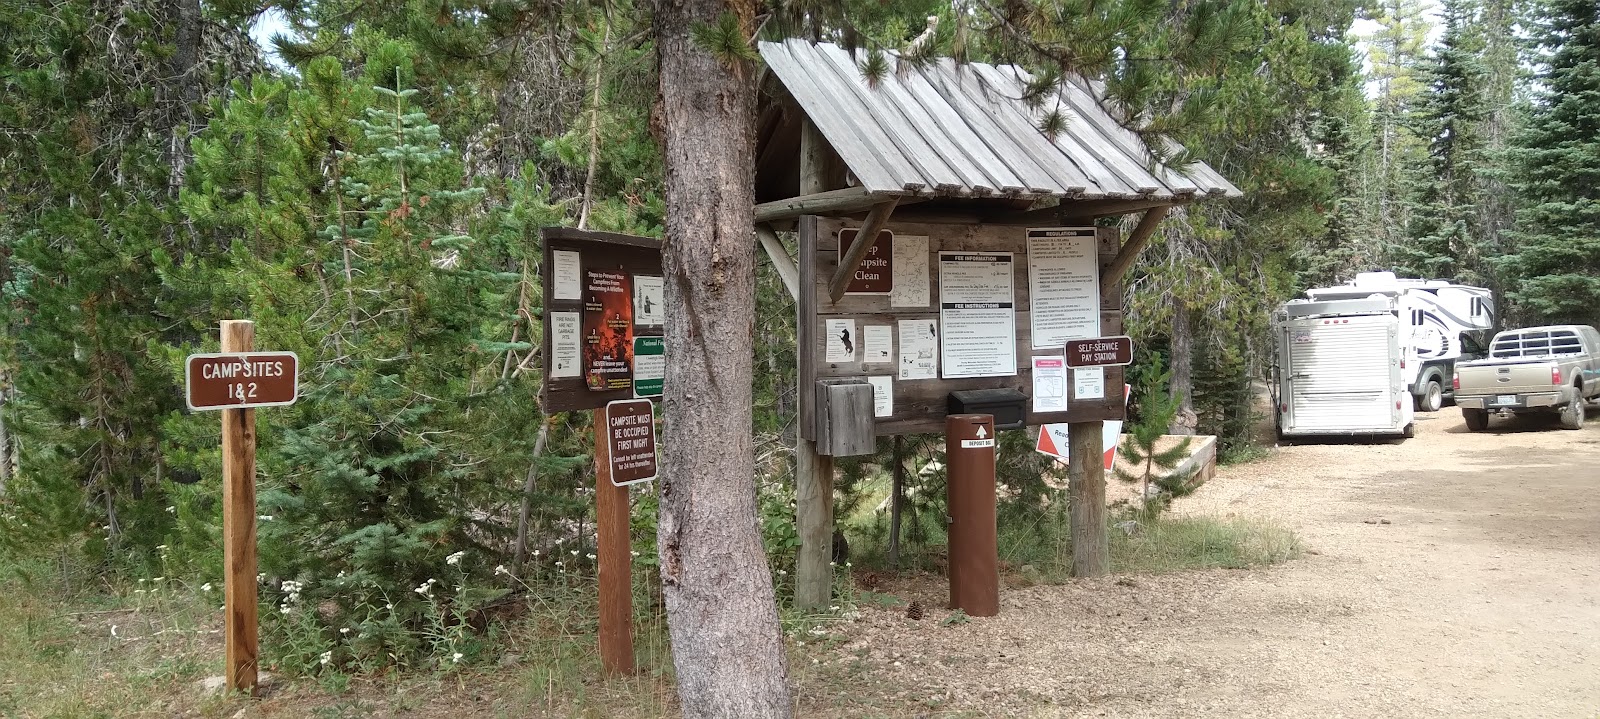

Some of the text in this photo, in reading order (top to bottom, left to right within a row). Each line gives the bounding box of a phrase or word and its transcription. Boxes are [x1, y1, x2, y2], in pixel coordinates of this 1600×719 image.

[855, 271, 879, 280] Clean
[1078, 342, 1118, 352] SELF-SERVICE
[1082, 352, 1117, 362] PAY STATION
[202, 362, 283, 379] CAMPSITES
[611, 414, 651, 426] CAMPSITE MUST
[615, 426, 648, 438] BE OCCUPIED
[618, 438, 648, 450] FIRST NIGHT
